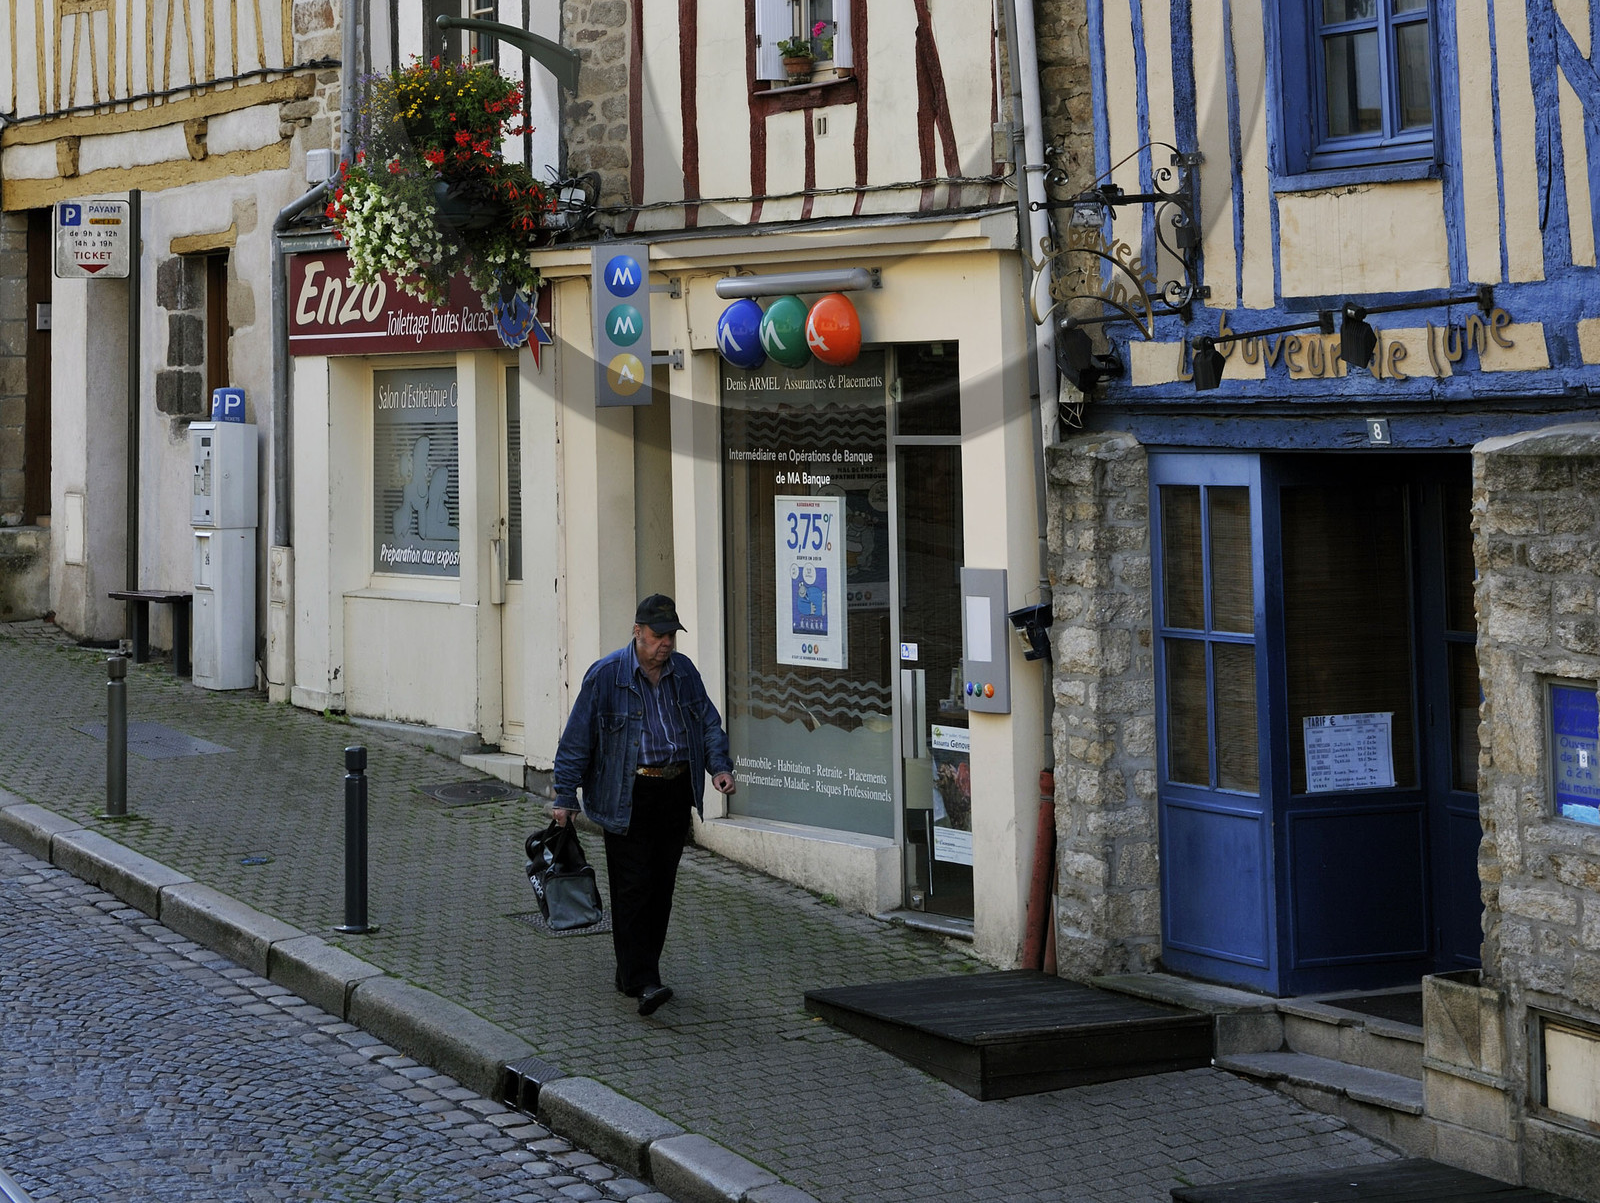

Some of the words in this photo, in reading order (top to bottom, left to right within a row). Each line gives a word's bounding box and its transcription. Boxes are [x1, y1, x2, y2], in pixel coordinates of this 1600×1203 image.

[65, 207, 76, 223] P
[74, 251, 113, 260] TICKET
[612, 267, 634, 286] M
[295, 260, 387, 326] Enzo
[387, 310, 429, 343] Toilettage
[430, 308, 459, 334] Toutes
[461, 306, 489, 333] Races
[613, 316, 635, 335] M
[1426, 307, 1513, 376] lune
[617, 364, 635, 385] A
[726, 377, 747, 391] Denis
[749, 376, 780, 390] ARMEL
[784, 376, 826, 390] Assurances
[828, 375, 836, 388] &
[838, 374, 883, 389] Placements
[224, 394, 241, 414] P
[378, 385, 399, 409] Salon
[401, 382, 448, 415] d'Esthétique
[450, 382, 458, 407] C
[1373, 423, 1382, 440] 8
[729, 449, 776, 461] Intermédiaire
[778, 453, 787, 461] en
[789, 449, 830, 465] Opérations
[832, 450, 842, 462] de
[844, 449, 873, 465] Banque
[776, 471, 786, 484] de
[787, 472, 800, 484] MA
[802, 472, 830, 487] Banque
[380, 543, 420, 566] Préparation
[422, 549, 436, 564] aux
[1308, 717, 1326, 728] TARIF
[1560, 737, 1596, 751] Ouvert
[1560, 751, 1573, 763] de
[736, 755, 772, 770] Automobile
[777, 759, 811, 775] Habitation
[817, 764, 842, 779] Retraite
[849, 768, 887, 784] Placements
[732, 770, 782, 787] Complémentaire
[784, 776, 810, 791] Maladie
[816, 781, 841, 797] Risques
[843, 784, 892, 803] Professionnels
